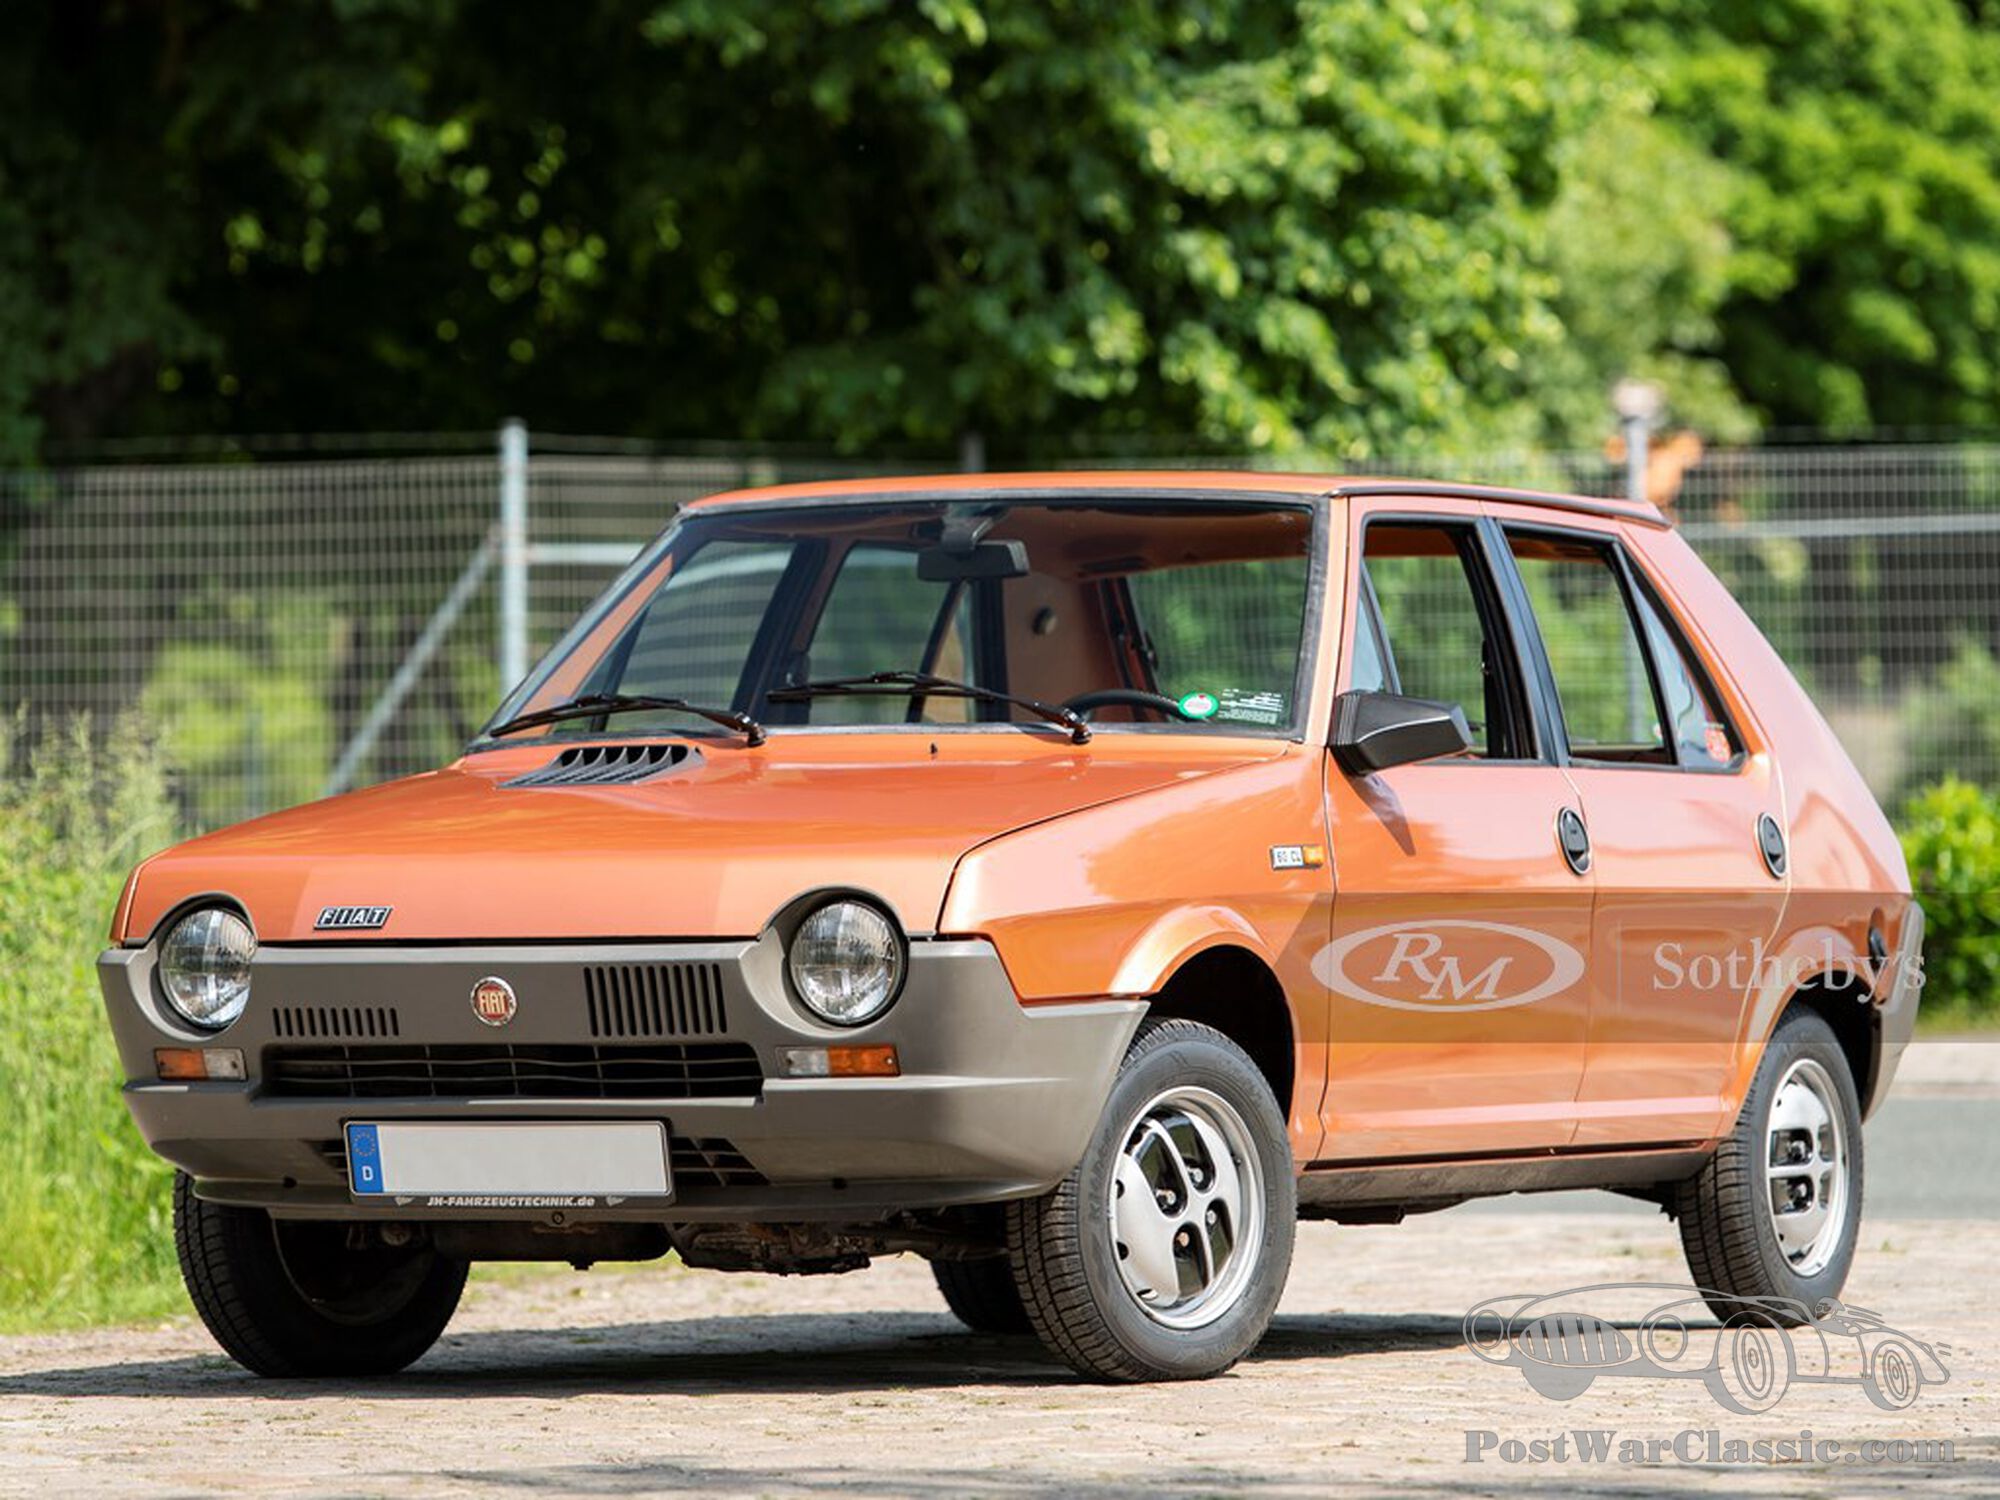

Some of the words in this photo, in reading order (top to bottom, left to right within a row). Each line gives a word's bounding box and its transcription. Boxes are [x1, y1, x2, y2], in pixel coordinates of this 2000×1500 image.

[317, 907, 387, 925] FIAT
[478, 990, 507, 1015] FIAT
[361, 1165, 374, 1182] D
[427, 1196, 596, 1207] JH-FAHRZEUGTECHNIK.de
